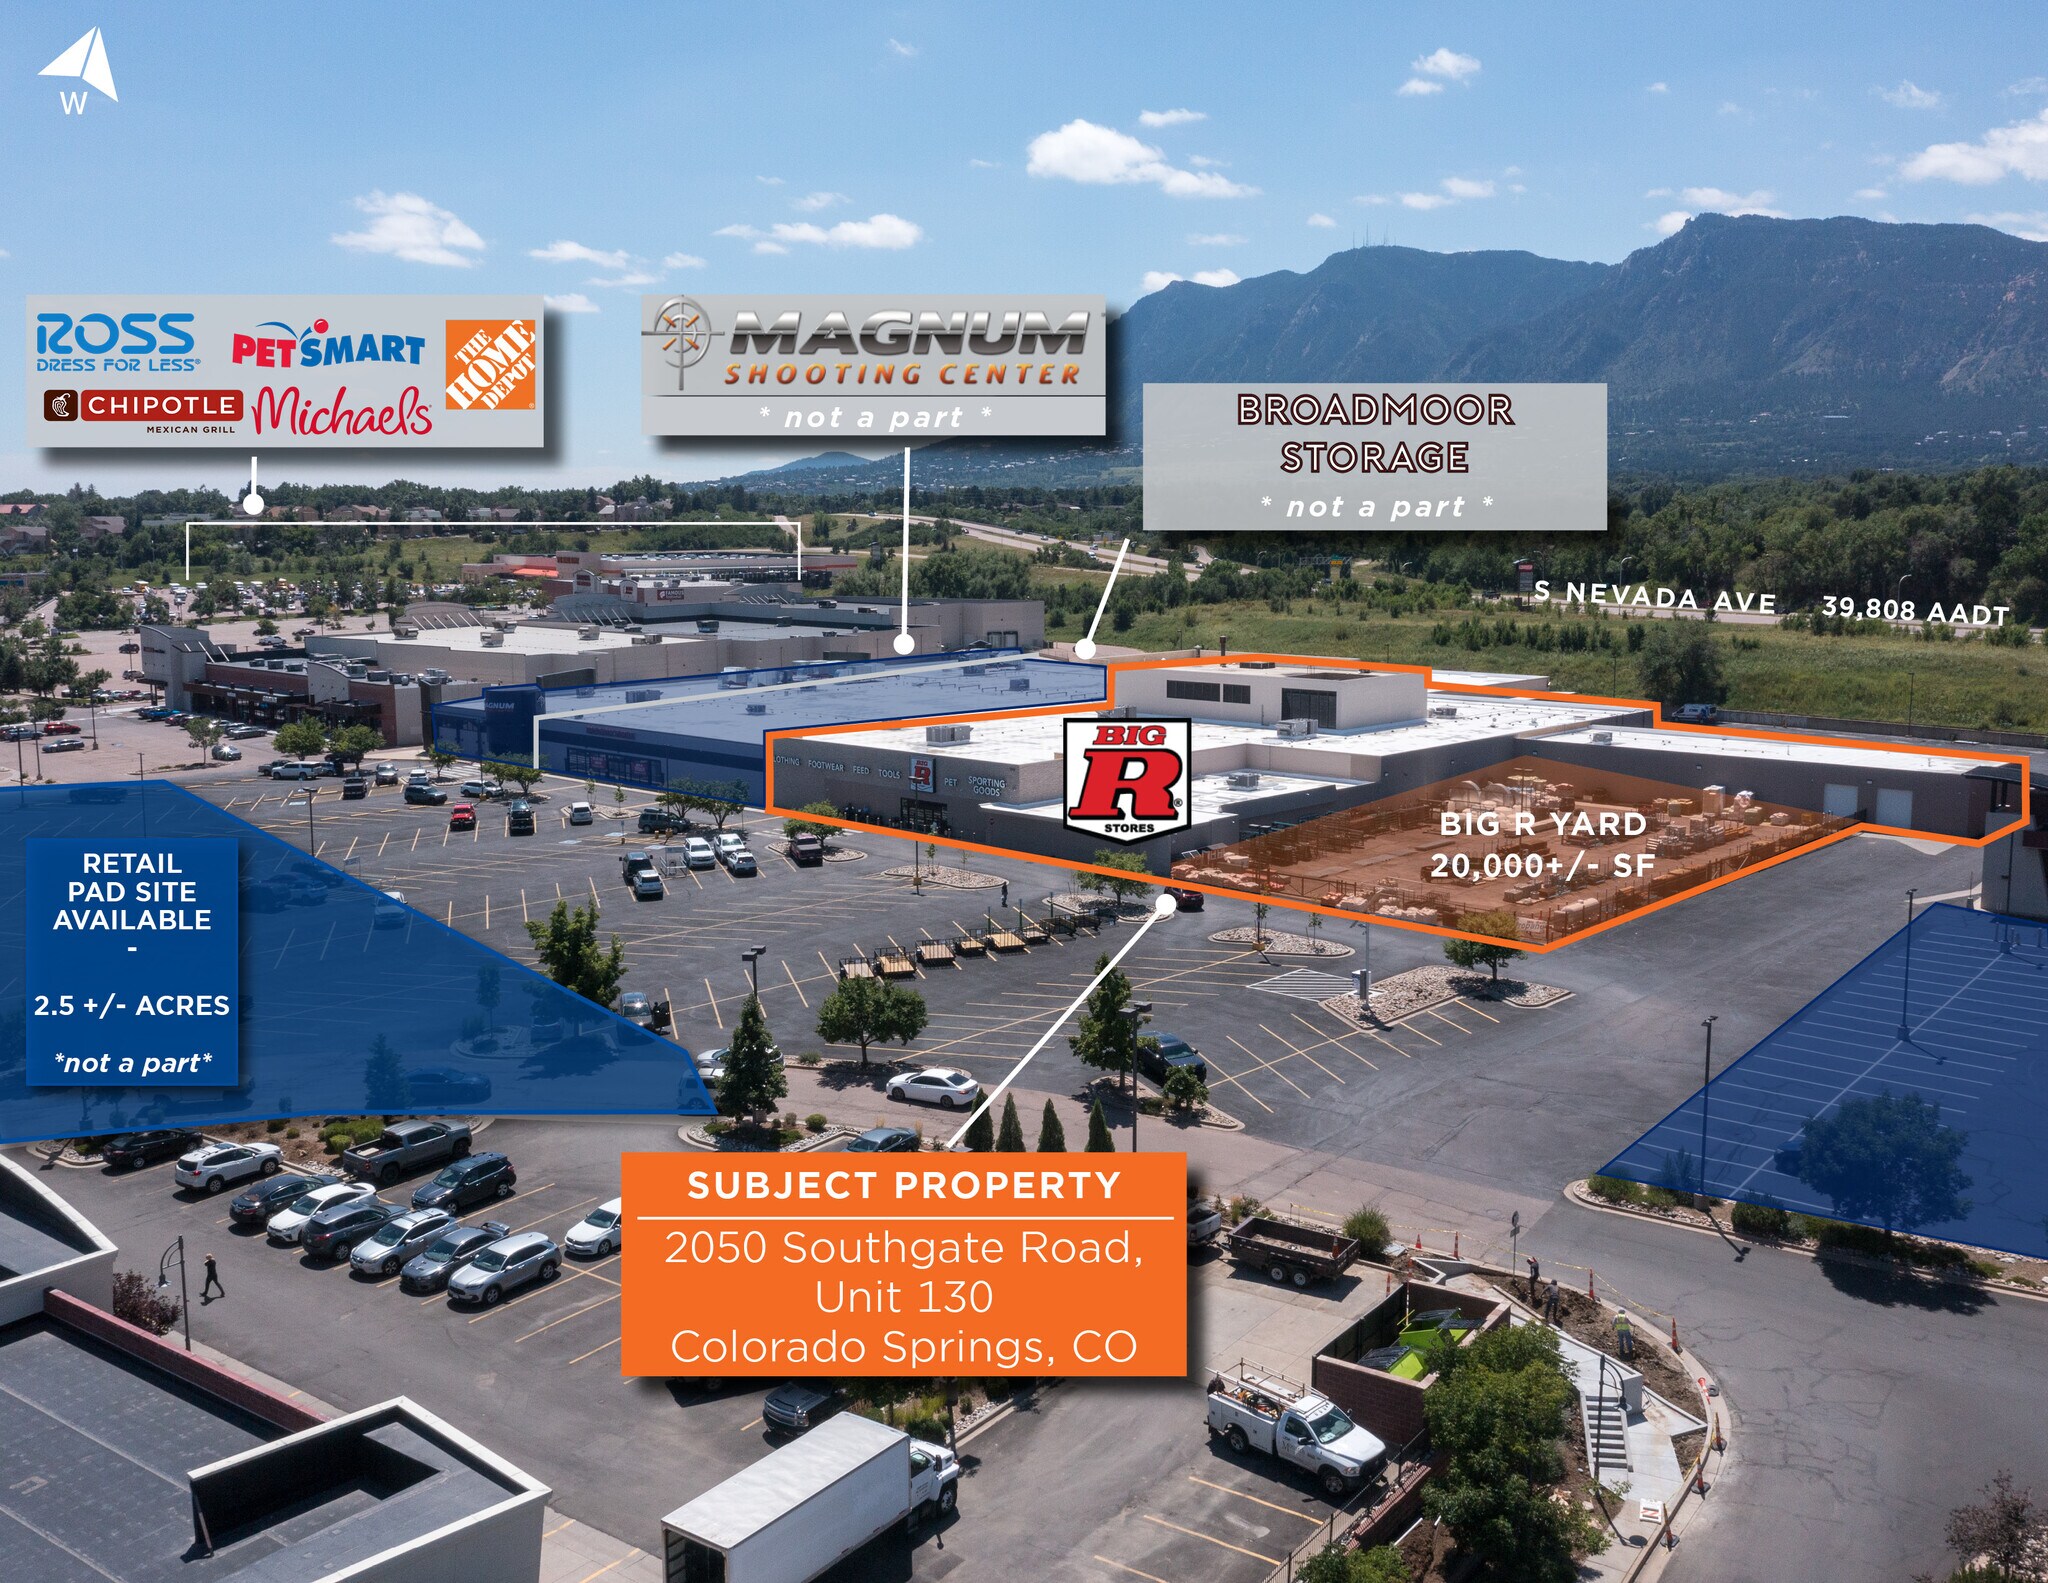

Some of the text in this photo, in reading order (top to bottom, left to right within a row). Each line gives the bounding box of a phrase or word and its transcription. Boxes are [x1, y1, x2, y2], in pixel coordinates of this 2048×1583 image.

[774, 755, 801, 766] LOTHING
[808, 759, 844, 772] FOOTWEAR
[852, 765, 870, 775] FEED
[878, 768, 901, 779] TOOLS
[944, 777, 957, 788] PET
[968, 776, 1006, 788] SPORTING
[973, 786, 1001, 797] GOODS
